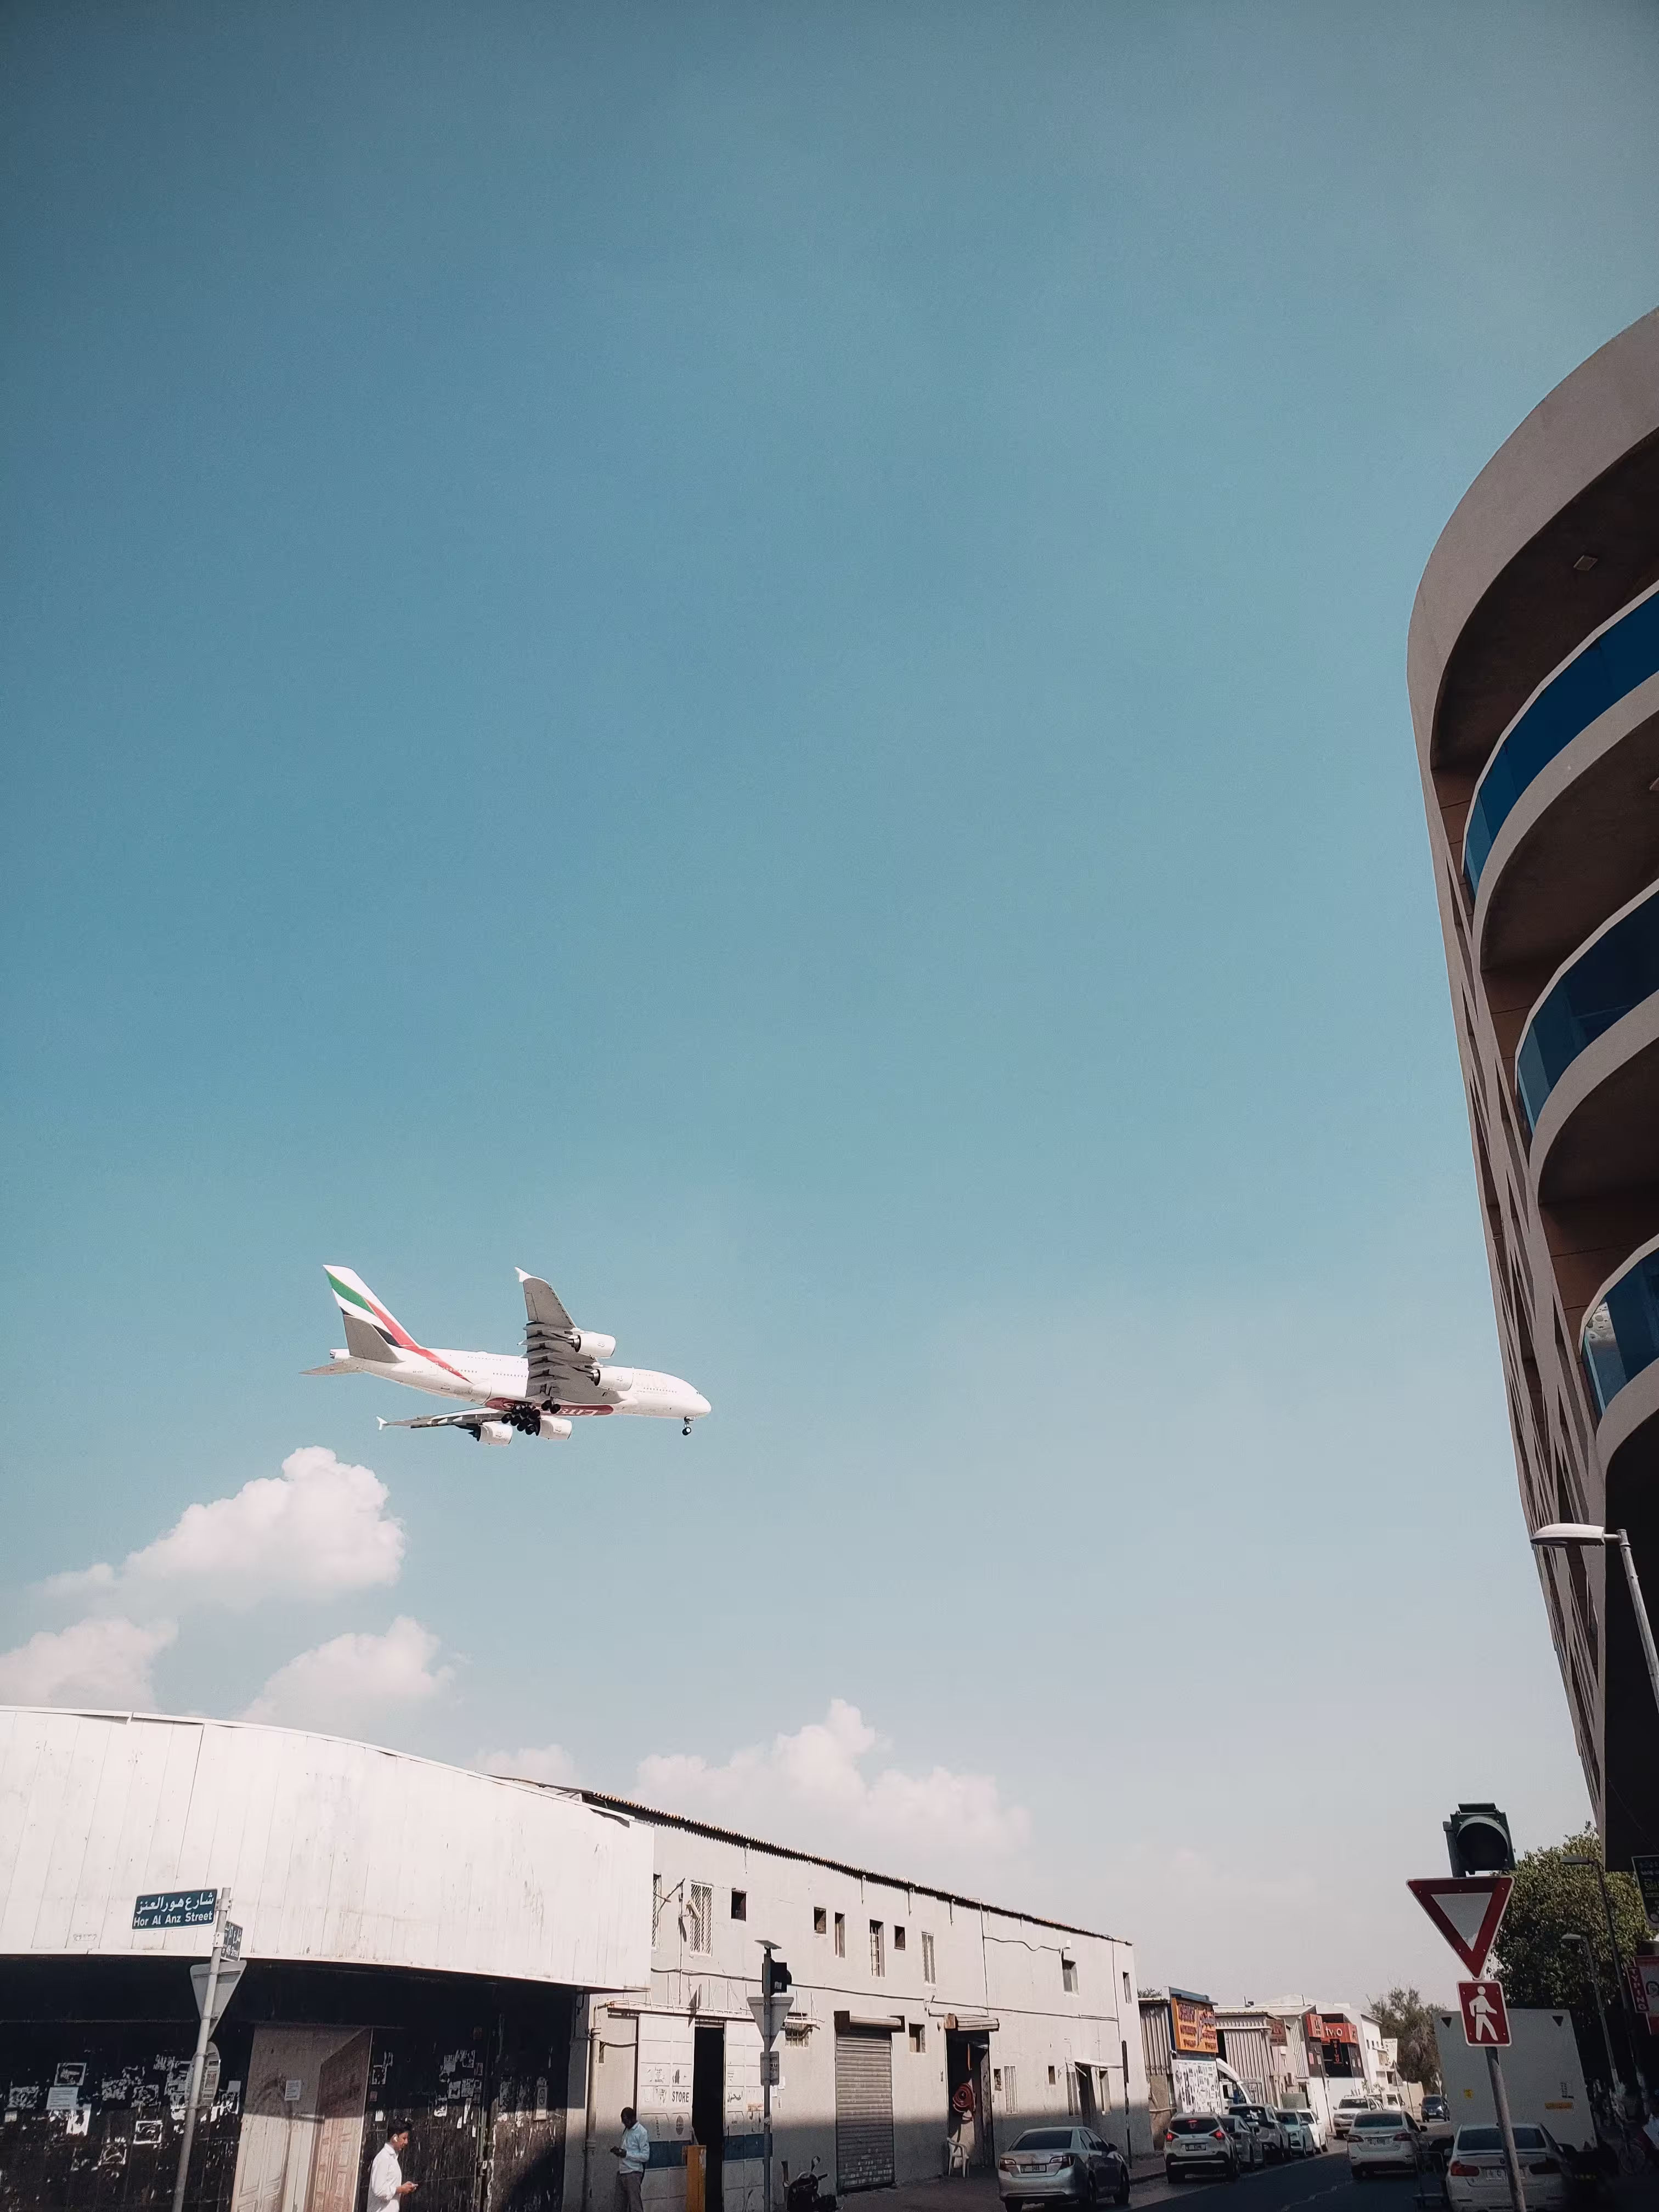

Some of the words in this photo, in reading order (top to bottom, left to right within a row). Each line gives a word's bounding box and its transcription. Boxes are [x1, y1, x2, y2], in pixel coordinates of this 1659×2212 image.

[136, 1895, 165, 1914] العنز
[162, 1898, 184, 1912] هور
[184, 1892, 214, 1910] شارع
[133, 1917, 149, 1927] Hor
[151, 1915, 161, 1925] Al
[165, 1914, 182, 1924] Anz
[184, 1910, 213, 1922] Street
[1325, 2025, 1342, 2036] two
[672, 2091, 690, 2103] STORE
